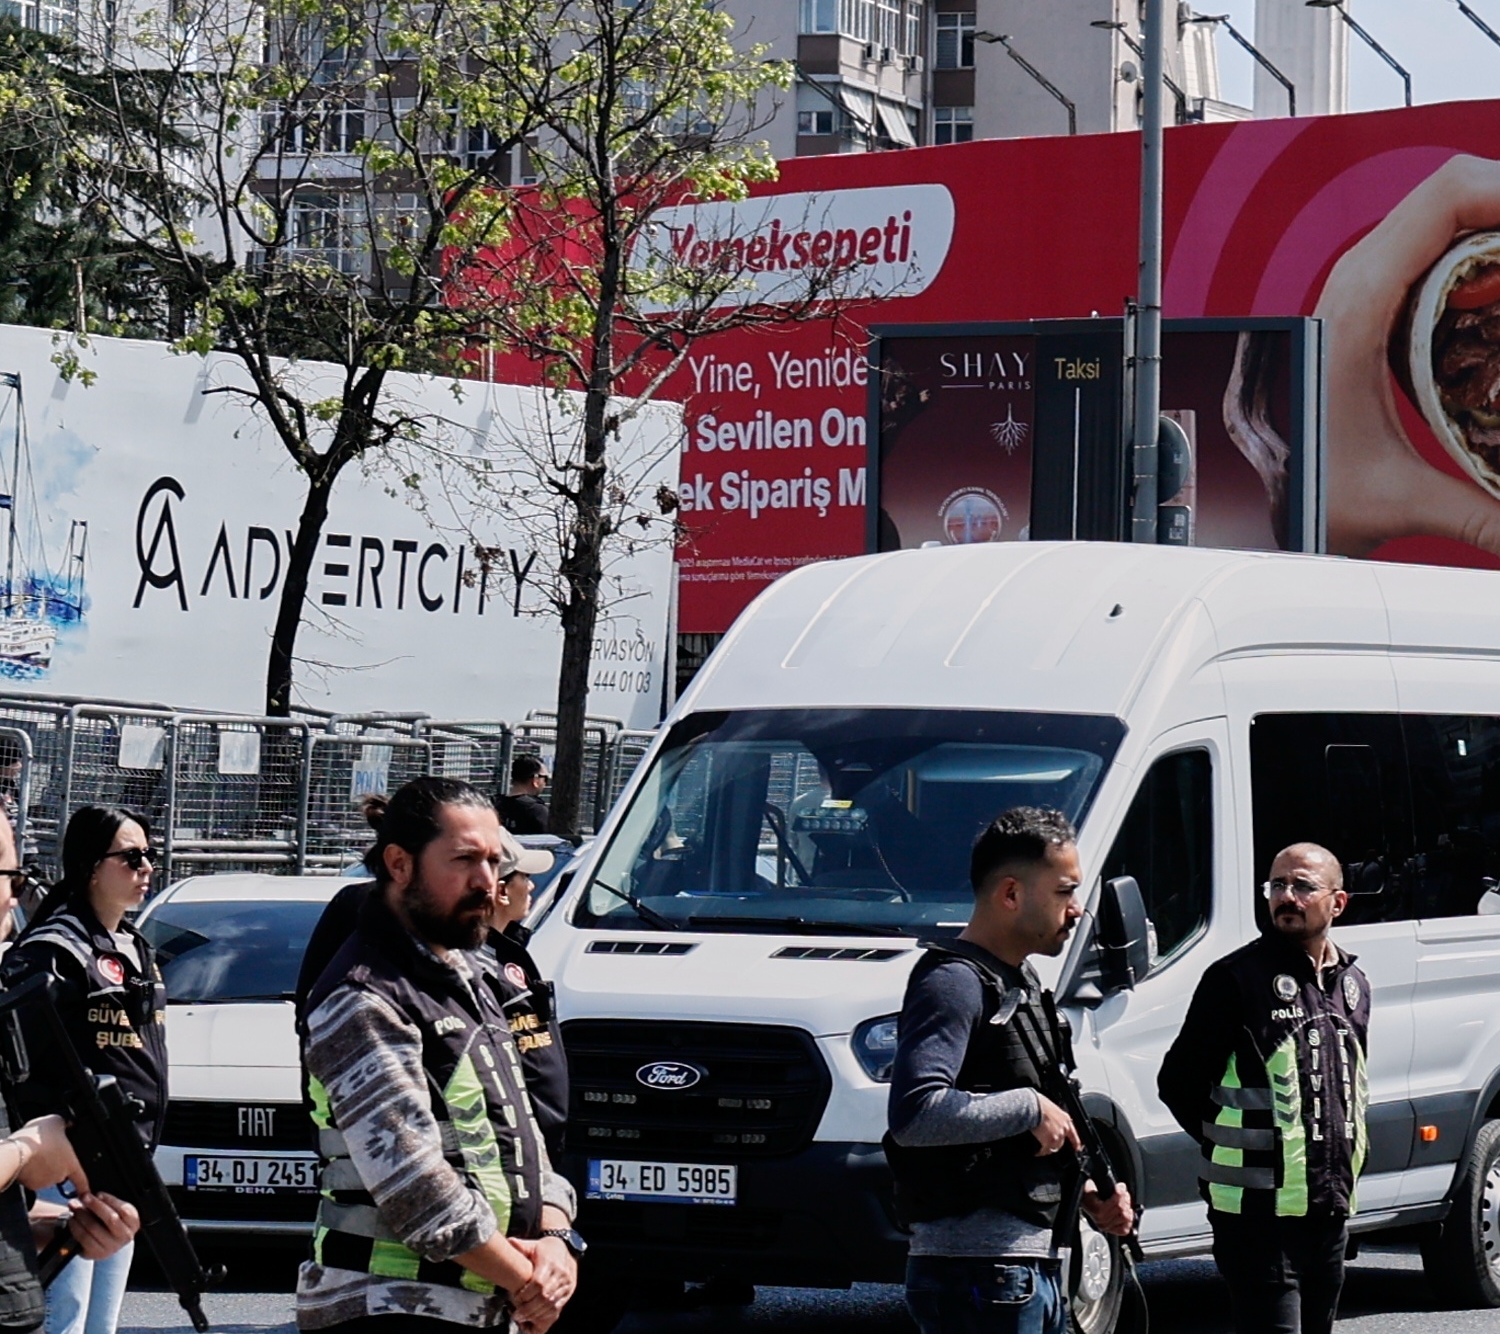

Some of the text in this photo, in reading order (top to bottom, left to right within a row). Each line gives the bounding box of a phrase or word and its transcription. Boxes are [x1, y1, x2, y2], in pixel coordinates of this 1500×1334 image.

[671, 210, 911, 278] Yemeksepeti
[689, 348, 868, 399] Yine, Yenide
[940, 352, 1030, 378] SHAY
[1054, 357, 1100, 380] Taksi
[988, 381, 1031, 390] PARIS
[696, 409, 813, 453] Sevilen
[720, 466, 831, 519] Sipariş
[593, 670, 652, 694] 444 01 03
[1271, 1006, 1304, 1020] POLİS
[647, 1065, 687, 1085] Ford
[238, 1107, 276, 1137] FIAT
[198, 1160, 223, 1183] 34
[233, 1160, 258, 1185] DJ
[267, 1161, 318, 1185] 2451
[603, 1164, 628, 1189] 34
[640, 1165, 665, 1191] ED
[678, 1167, 730, 1195] 5985
[235, 1186, 276, 1195] DEHA
